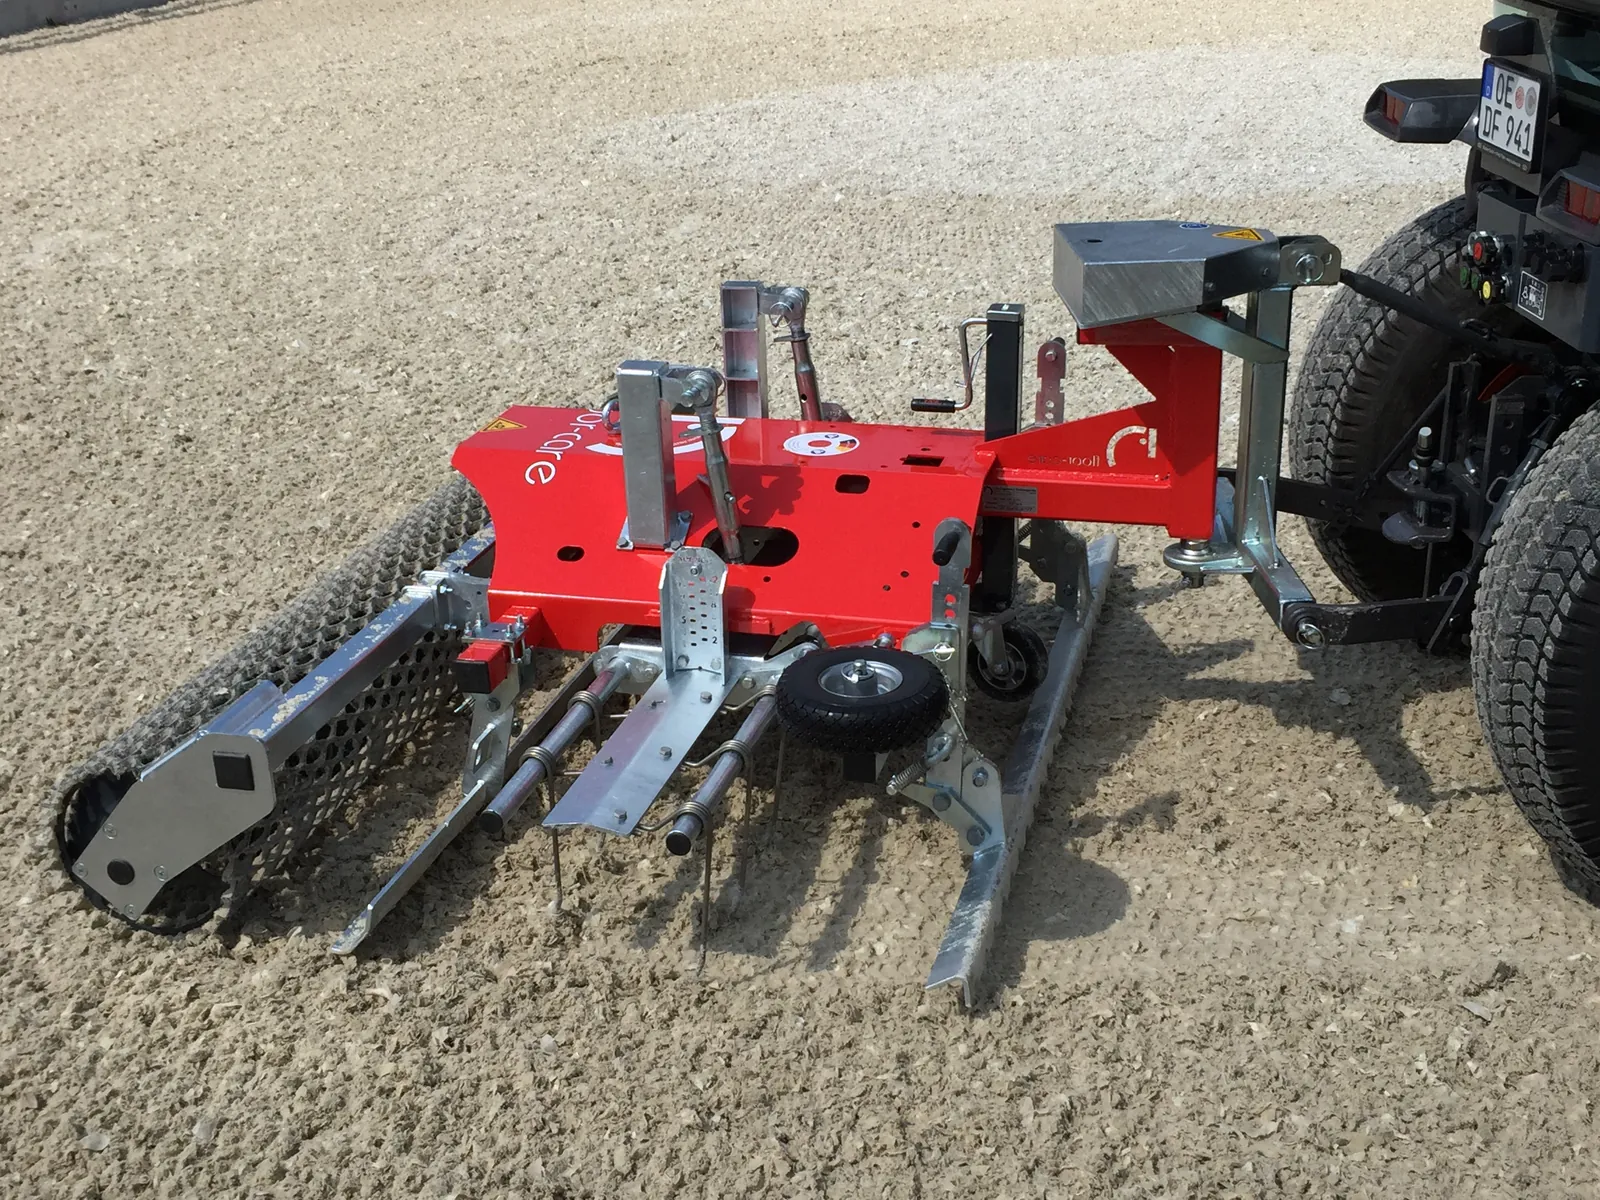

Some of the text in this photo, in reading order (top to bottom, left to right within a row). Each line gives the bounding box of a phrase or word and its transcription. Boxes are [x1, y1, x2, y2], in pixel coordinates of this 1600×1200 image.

[1496, 73, 1515, 109] OE
[1483, 105, 1502, 140] DF
[1506, 115, 1531, 156] 941
